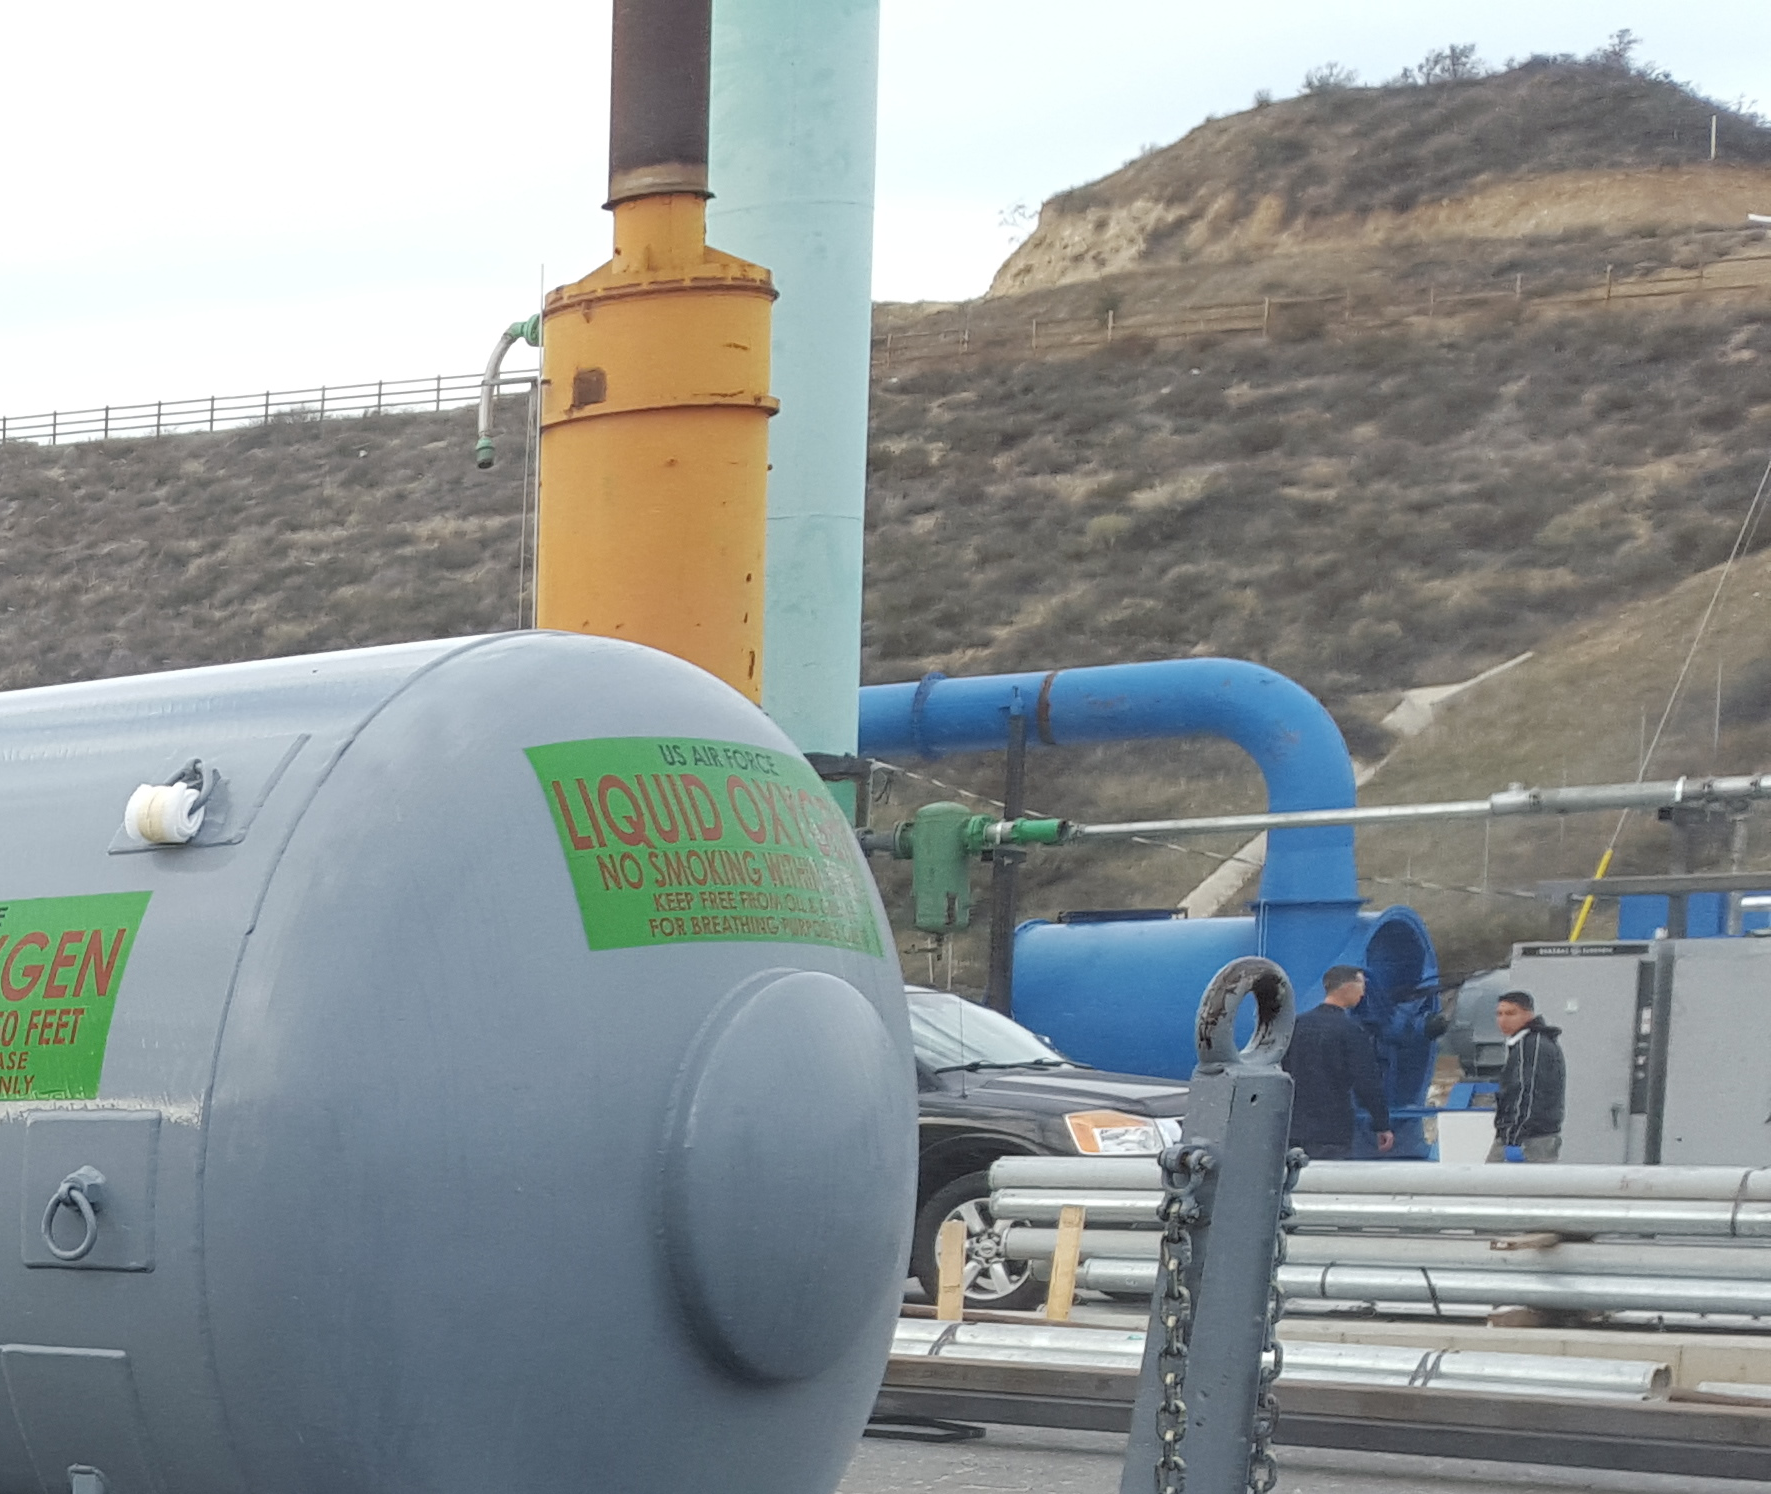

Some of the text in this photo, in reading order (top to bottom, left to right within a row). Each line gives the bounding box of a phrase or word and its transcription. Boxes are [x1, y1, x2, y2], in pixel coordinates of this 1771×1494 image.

[660, 745, 779, 776] US AIR FORCE
[552, 774, 723, 850] LIQUID
[596, 852, 643, 890] NO
[648, 850, 762, 888] SMOKING
[653, 891, 694, 912] KEEP
[699, 890, 737, 911] FREE
[740, 891, 780, 911] FROM
[649, 915, 687, 937] FOR
[691, 914, 779, 937] BREATHING
[24, 1008, 85, 1046] FEET
